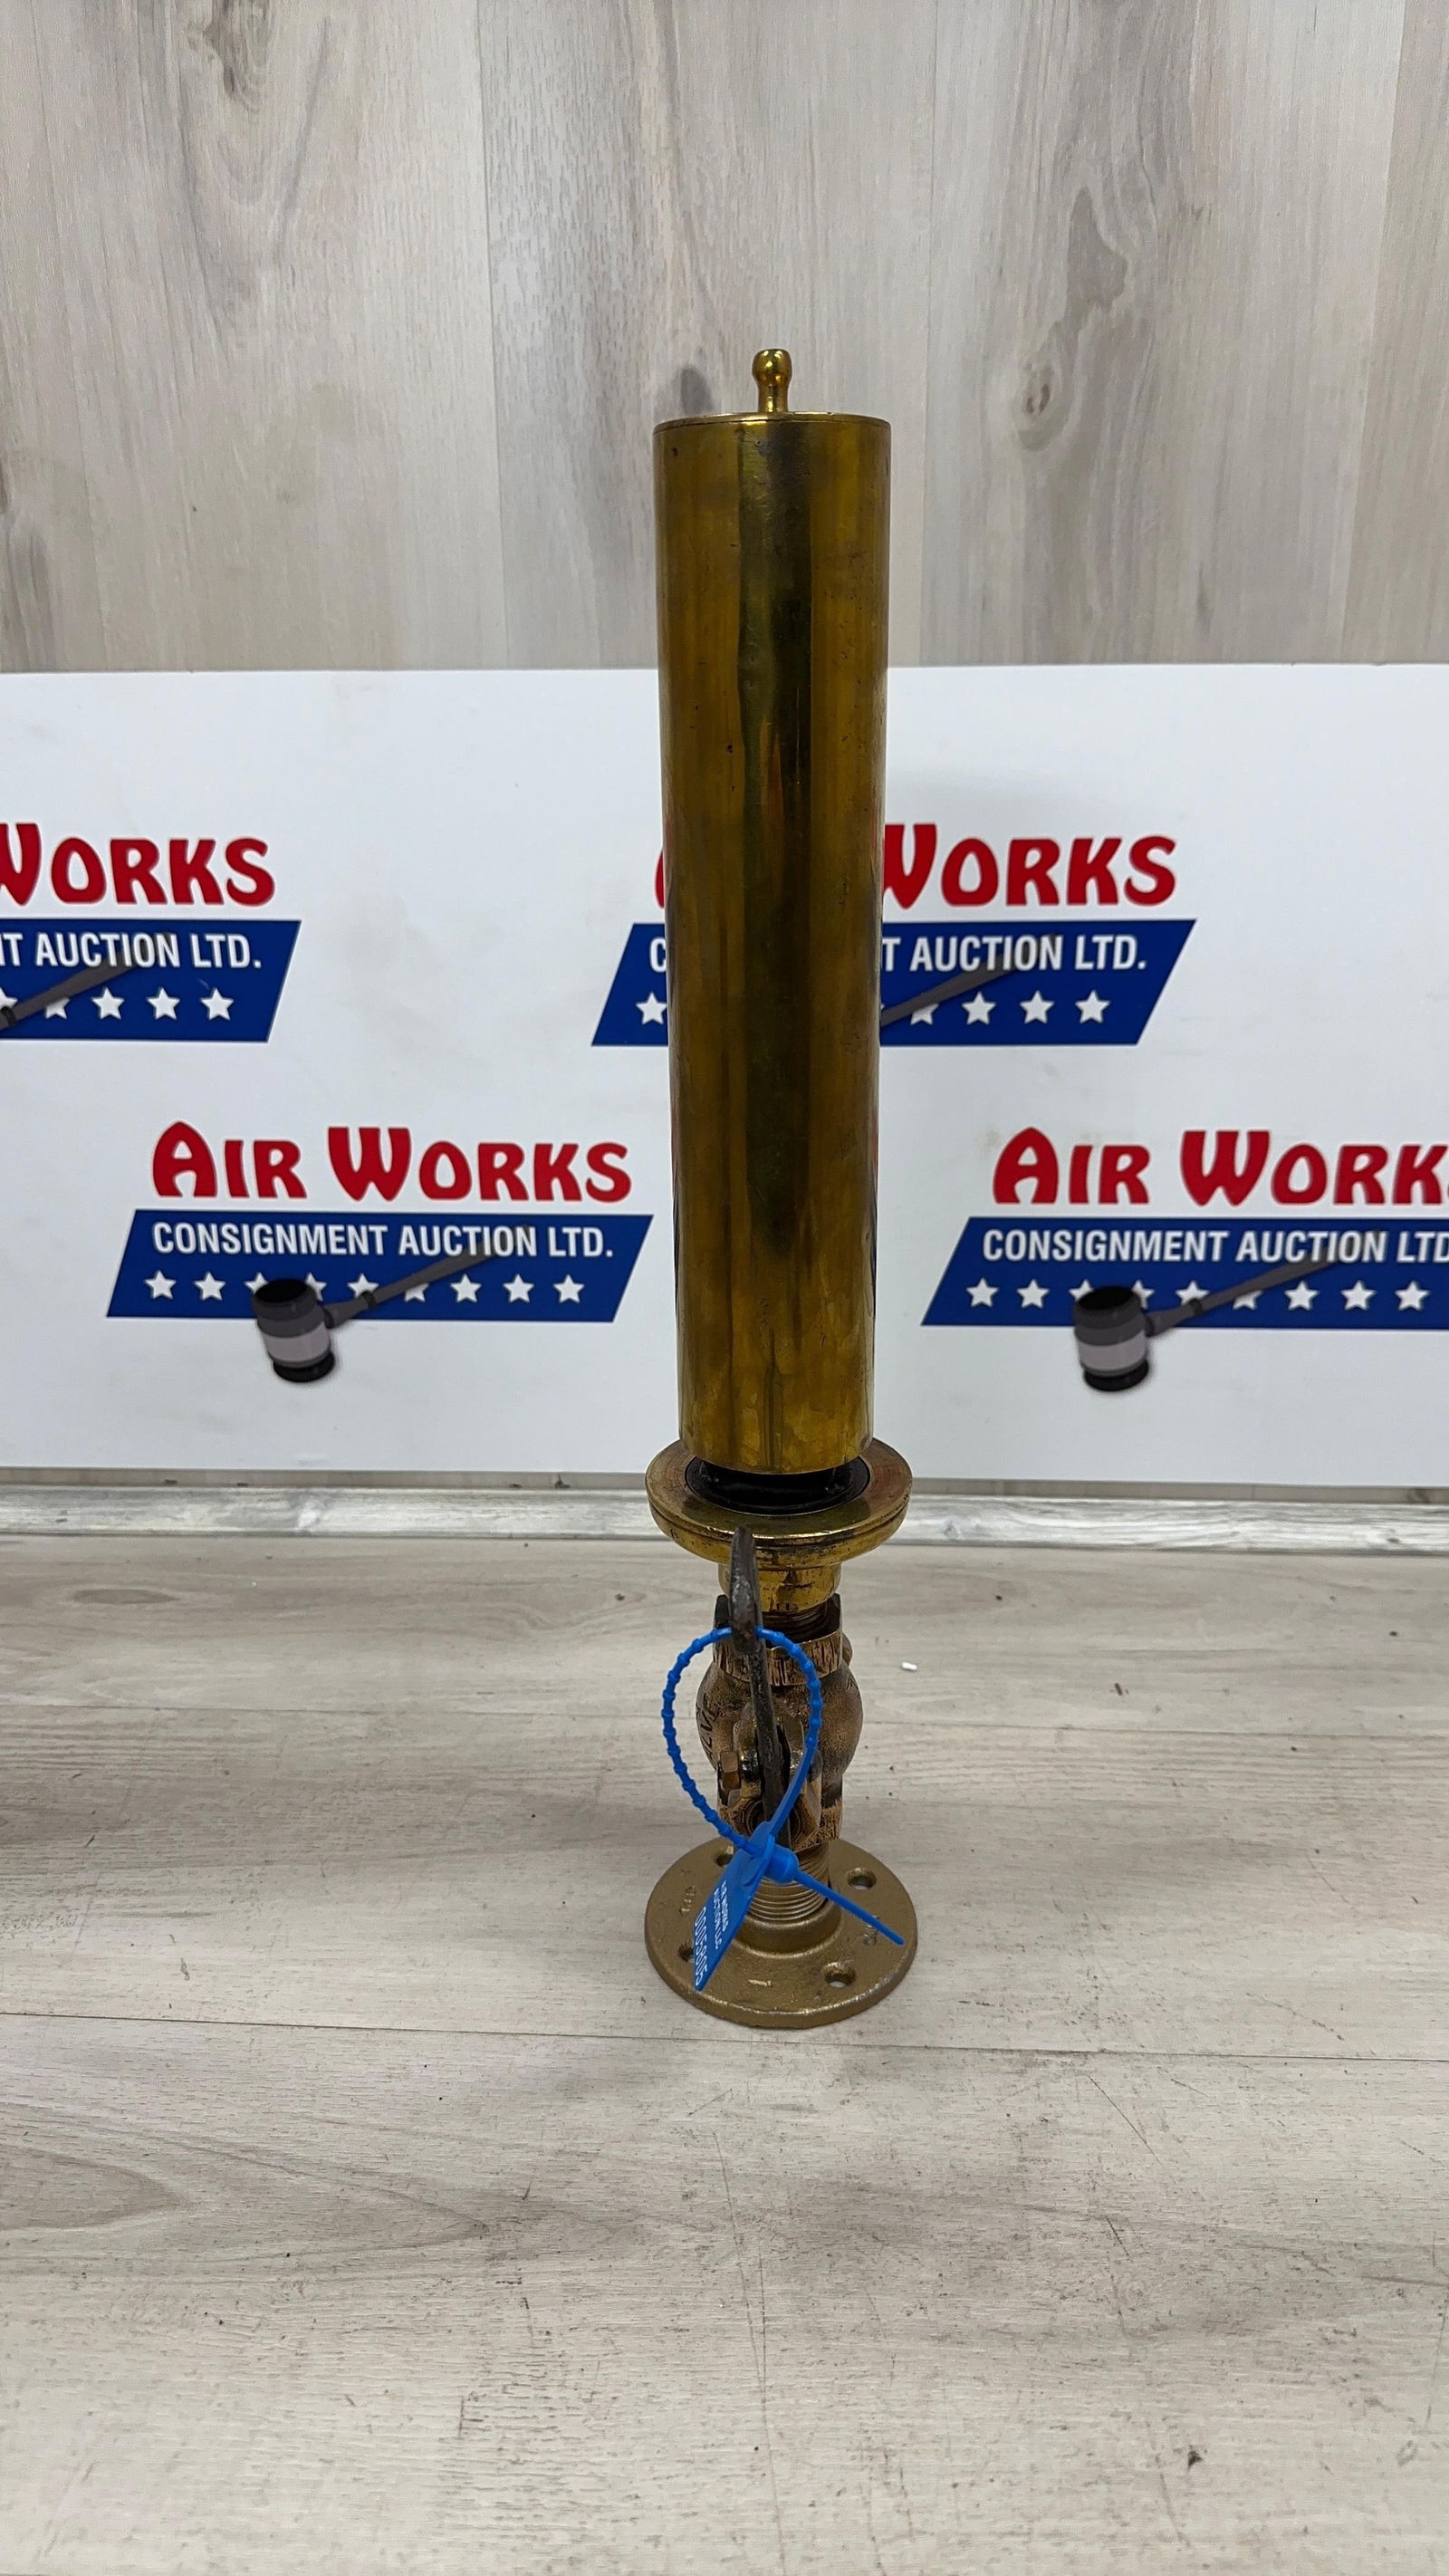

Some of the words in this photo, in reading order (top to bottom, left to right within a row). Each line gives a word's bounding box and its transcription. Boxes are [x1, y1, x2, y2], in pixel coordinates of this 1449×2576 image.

[36, 932, 180, 967] AUCTION
[189, 934, 262, 968] LTD.
[909, 936, 1063, 971] AUCTION
[1074, 935, 1147, 970] LTD.
[152, 1120, 307, 1198] AIR
[327, 1126, 631, 1203] WORKS
[993, 1127, 1150, 1205] AIR
[1180, 1129, 1449, 1206] WORK
[152, 1222, 388, 1255] CONSIGNMENT
[398, 1225, 537, 1257] AUCTION
[548, 1226, 613, 1257] LTD.
[983, 1229, 1229, 1262] CONSIGNMENT
[1235, 1230, 1387, 1264] AUCTION
